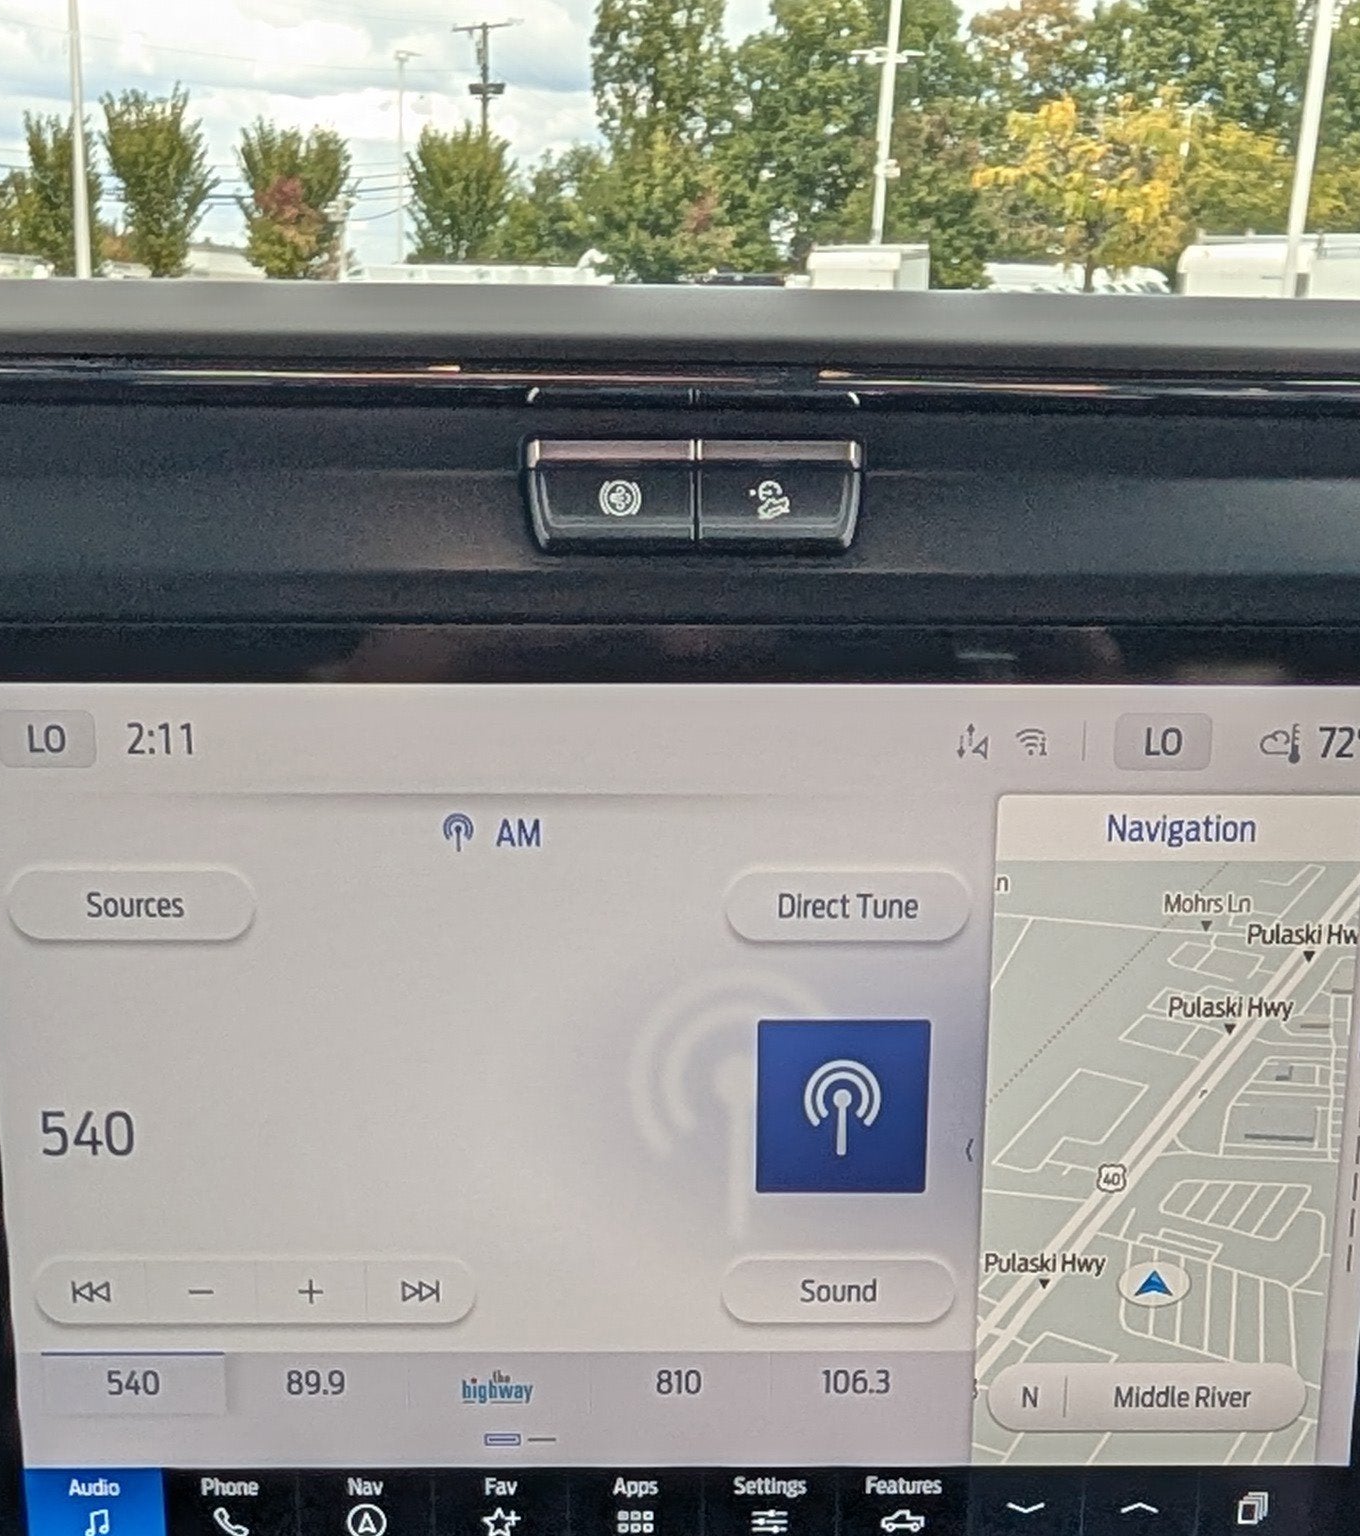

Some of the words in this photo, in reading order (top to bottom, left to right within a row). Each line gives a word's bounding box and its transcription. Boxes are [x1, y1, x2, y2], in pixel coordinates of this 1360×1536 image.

[26, 724, 66, 754] LO
[126, 722, 195, 755] 2:11
[1144, 728, 1182, 756] LO
[496, 819, 541, 848] AM
[1107, 814, 1256, 846] Navigation
[86, 891, 184, 919] Sources
[778, 893, 850, 919] Direct
[855, 894, 919, 919] Tune
[1164, 894, 1223, 913] Mohrs
[1228, 894, 1251, 913] Ln
[1248, 924, 1322, 945] Pulaski
[1169, 998, 1243, 1017] Pulaski
[1248, 998, 1293, 1021] Hwy
[40, 1110, 136, 1157] 540
[1104, 1171, 1121, 1186] 40
[984, 1254, 1056, 1276] Pulaski
[1061, 1254, 1106, 1278] Hwy
[800, 1279, 878, 1304] Sound
[106, 1370, 160, 1397] 540
[286, 1370, 346, 1397] 89.9
[462, 1378, 533, 1403] highway
[656, 1370, 701, 1396] 810
[821, 1369, 890, 1395] 106.3
[1021, 1388, 1038, 1409] N
[1114, 1385, 1188, 1409] Middle
[1194, 1385, 1251, 1410] River
[69, 1478, 121, 1497] Audio
[201, 1478, 259, 1497] Phone
[348, 1478, 383, 1496] Nav
[484, 1478, 517, 1496] Fav
[613, 1478, 658, 1500] Apps
[734, 1476, 807, 1499] Settings
[865, 1476, 942, 1495] Features
